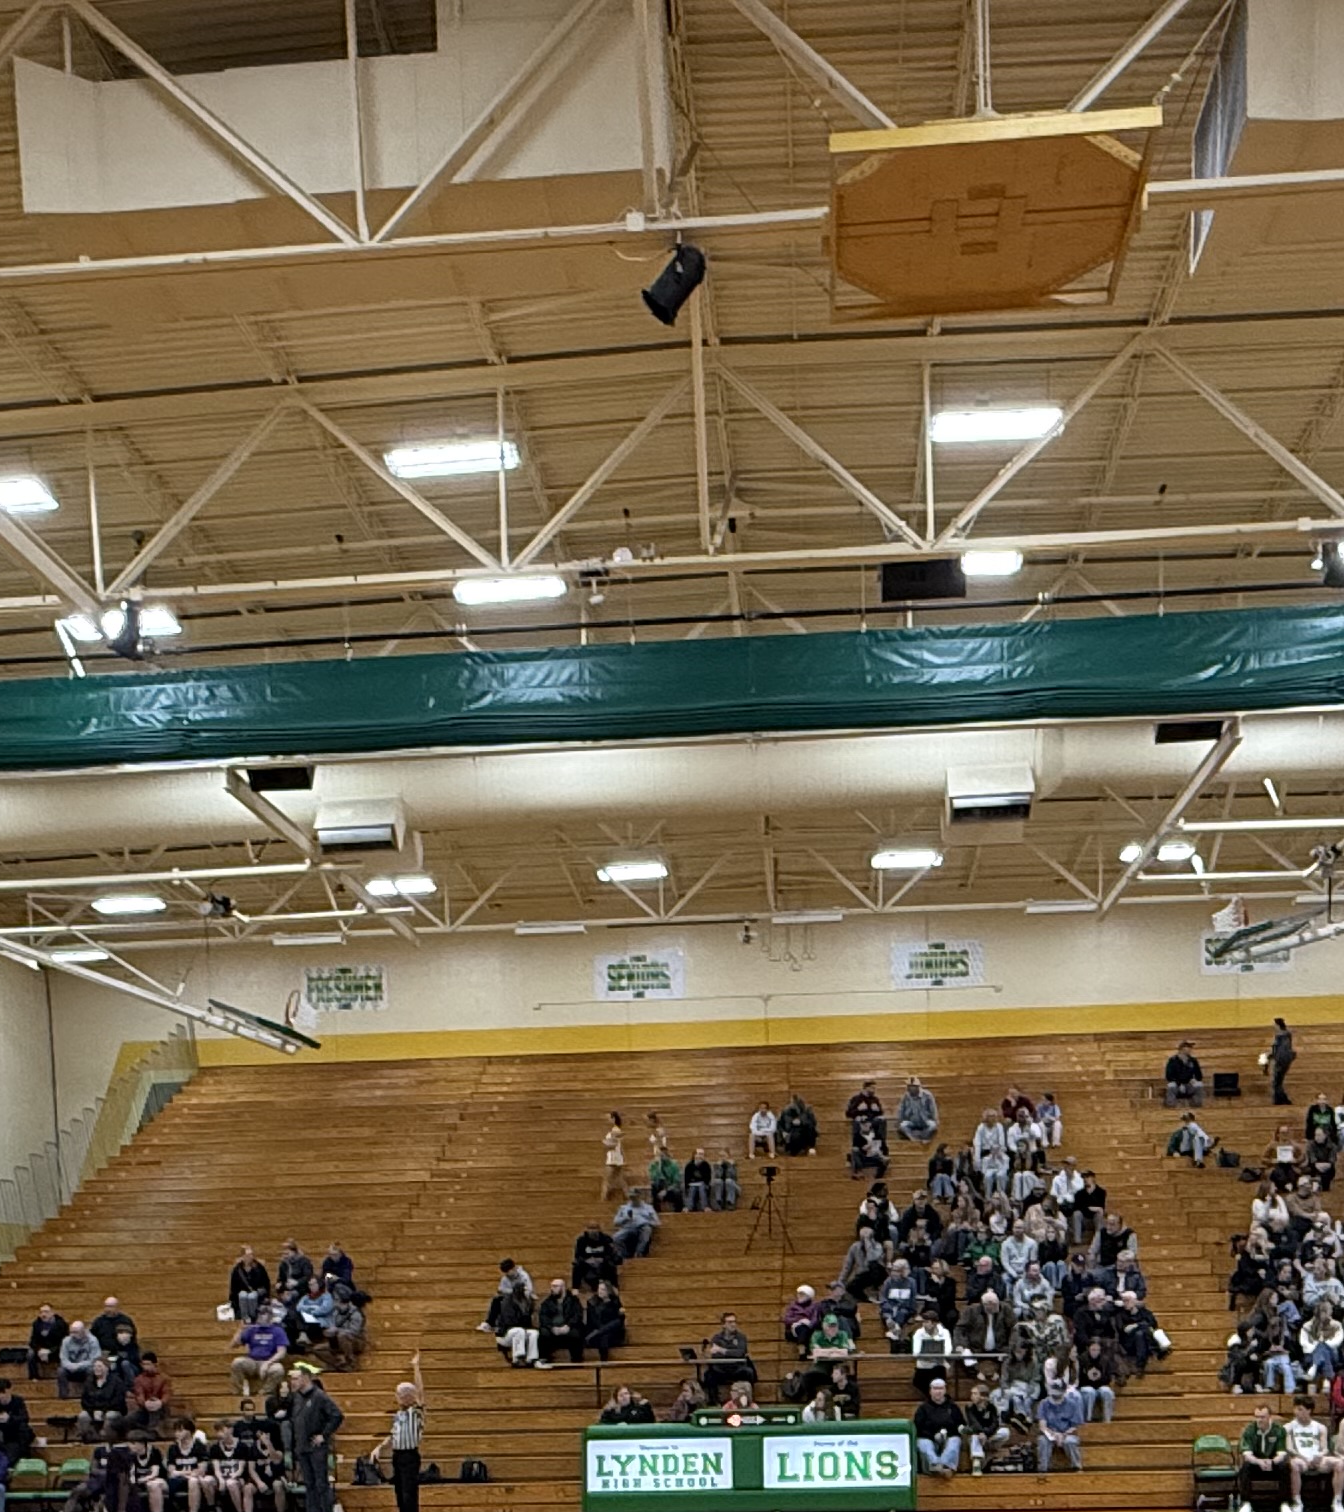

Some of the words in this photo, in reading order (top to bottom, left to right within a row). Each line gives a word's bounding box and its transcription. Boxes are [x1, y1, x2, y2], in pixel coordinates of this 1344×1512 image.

[595, 1452, 724, 1477] LYNDEN
[776, 1450, 899, 1482] LIONS
[601, 1478, 642, 1489] HIGH
[653, 1476, 718, 1488] SCHOOL
